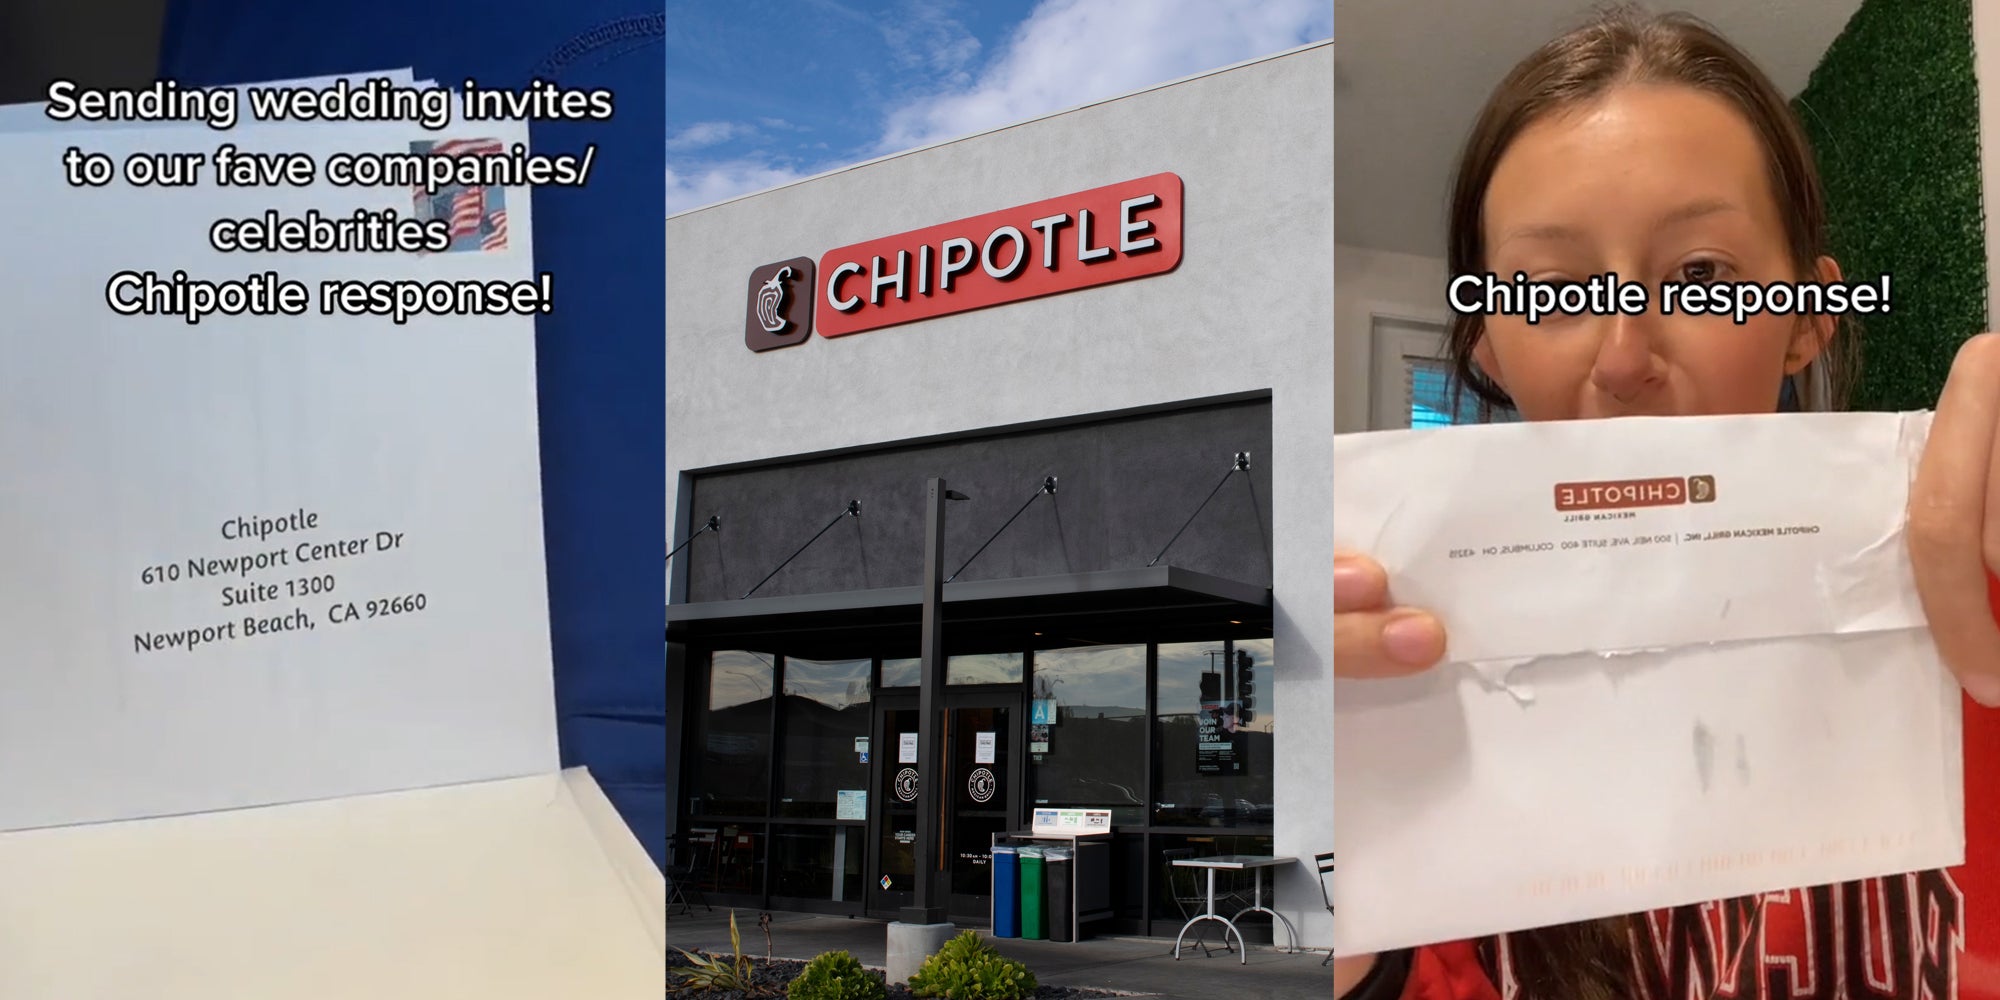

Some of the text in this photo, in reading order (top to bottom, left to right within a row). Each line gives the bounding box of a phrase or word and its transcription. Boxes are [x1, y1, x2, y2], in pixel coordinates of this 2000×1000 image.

[826, 193, 1162, 313] CHIPOTLE
[221, 508, 318, 541] Chipotle
[141, 530, 404, 585] 610 Newport Center Dr
[221, 574, 335, 606] Suite 1300
[133, 593, 427, 652] Newport Beach, CA 92660
[1034, 705, 1045, 720] A
[1199, 726, 1216, 734] OUR
[1199, 734, 1221, 742] TEAM
[970, 770, 993, 783] CHIPOTLE
